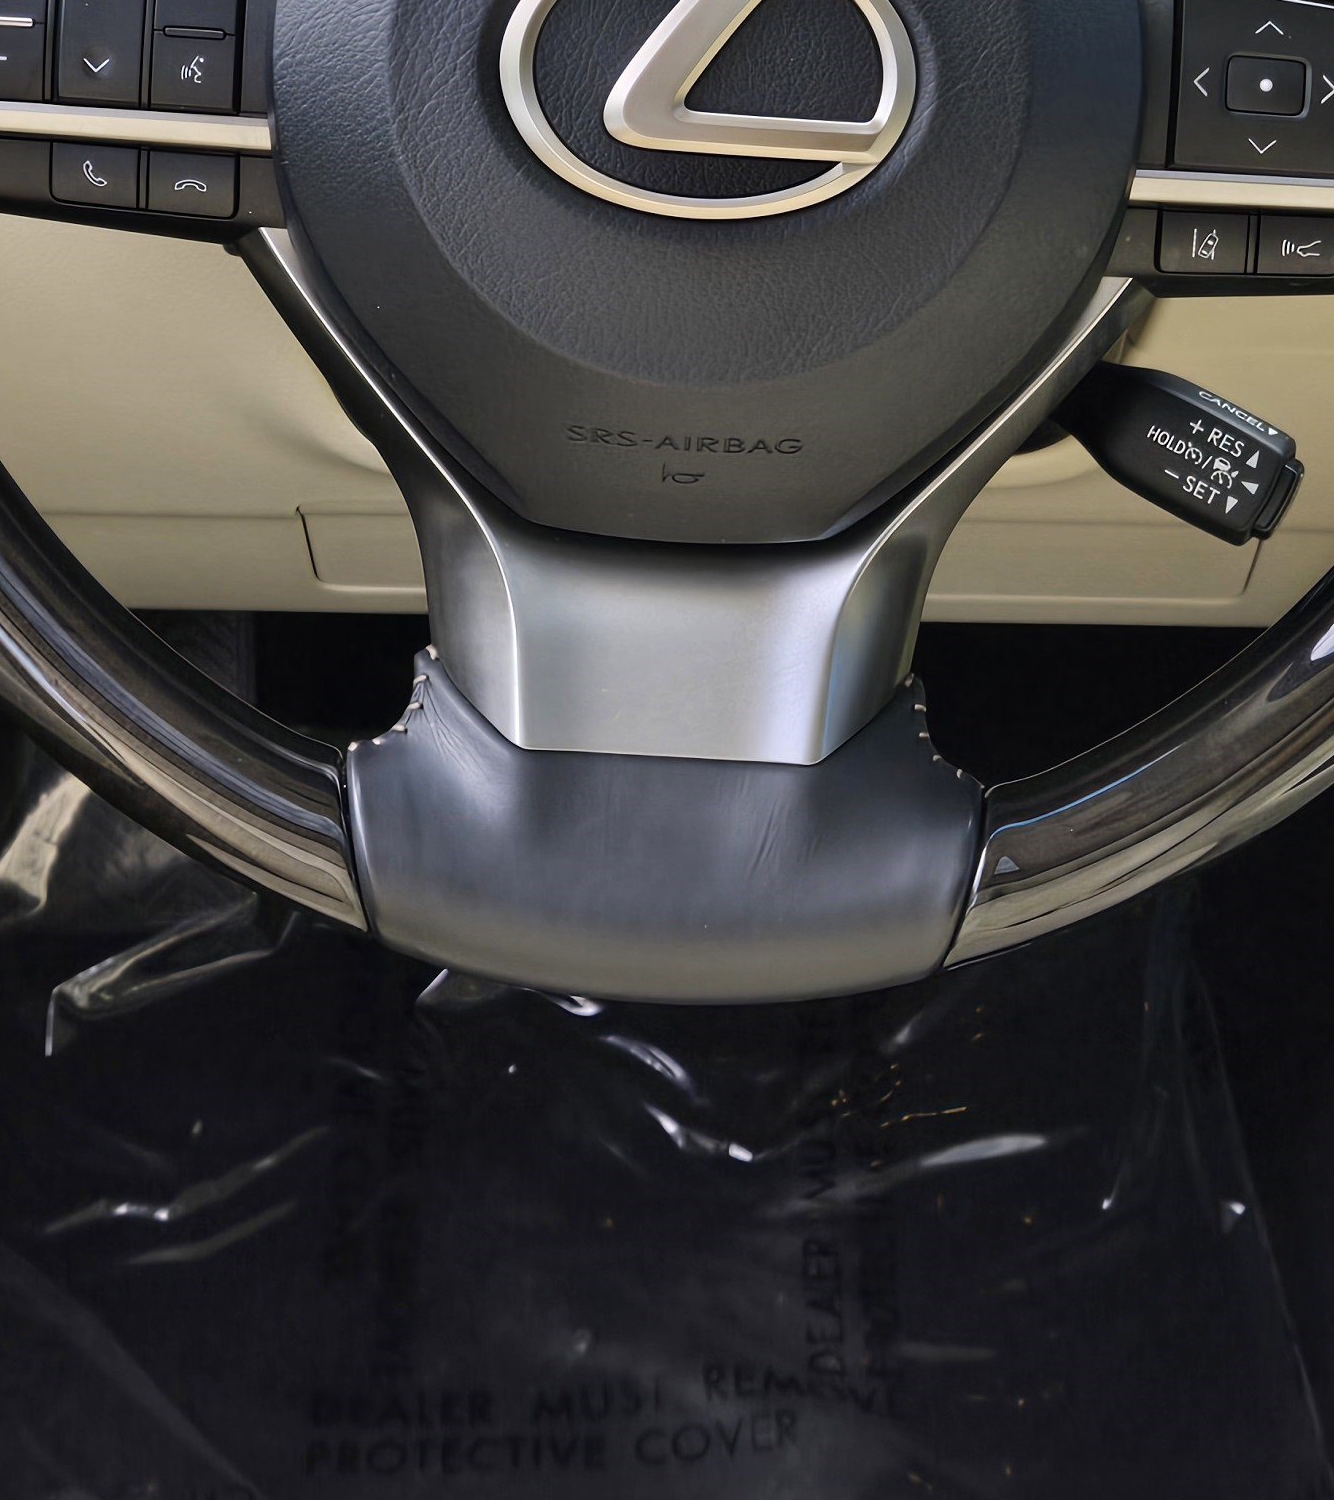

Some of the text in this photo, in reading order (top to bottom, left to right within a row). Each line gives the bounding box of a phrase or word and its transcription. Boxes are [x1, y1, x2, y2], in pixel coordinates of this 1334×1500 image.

[1198, 390, 1266, 432] CANCEL
[566, 425, 804, 455] SRS-AIRBAG
[1146, 425, 1186, 455] HOLD
[1207, 427, 1245, 458] RES
[1182, 475, 1221, 505] SET
[633, 1408, 799, 1466] COVER
